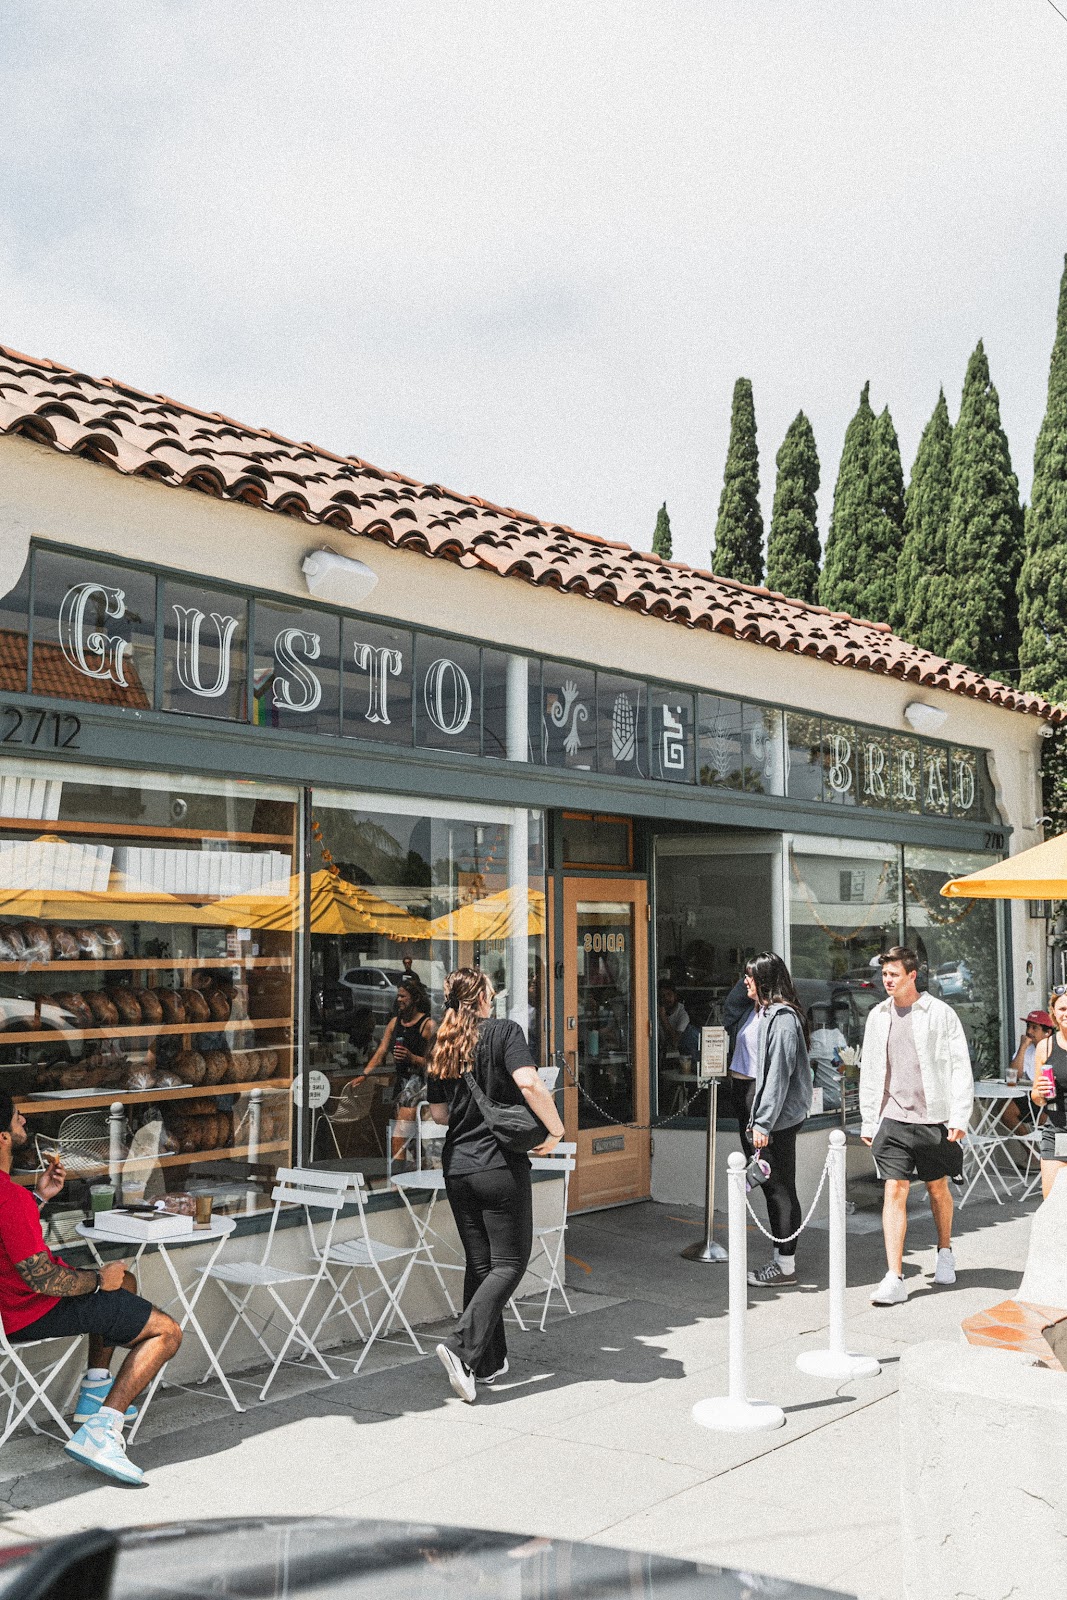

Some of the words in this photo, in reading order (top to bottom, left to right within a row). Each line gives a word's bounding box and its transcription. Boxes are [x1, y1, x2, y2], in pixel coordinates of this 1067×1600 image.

[58, 582, 472, 735] GUSTO
[3, 707, 81, 749] 2712
[824, 733, 975, 810] BREAD
